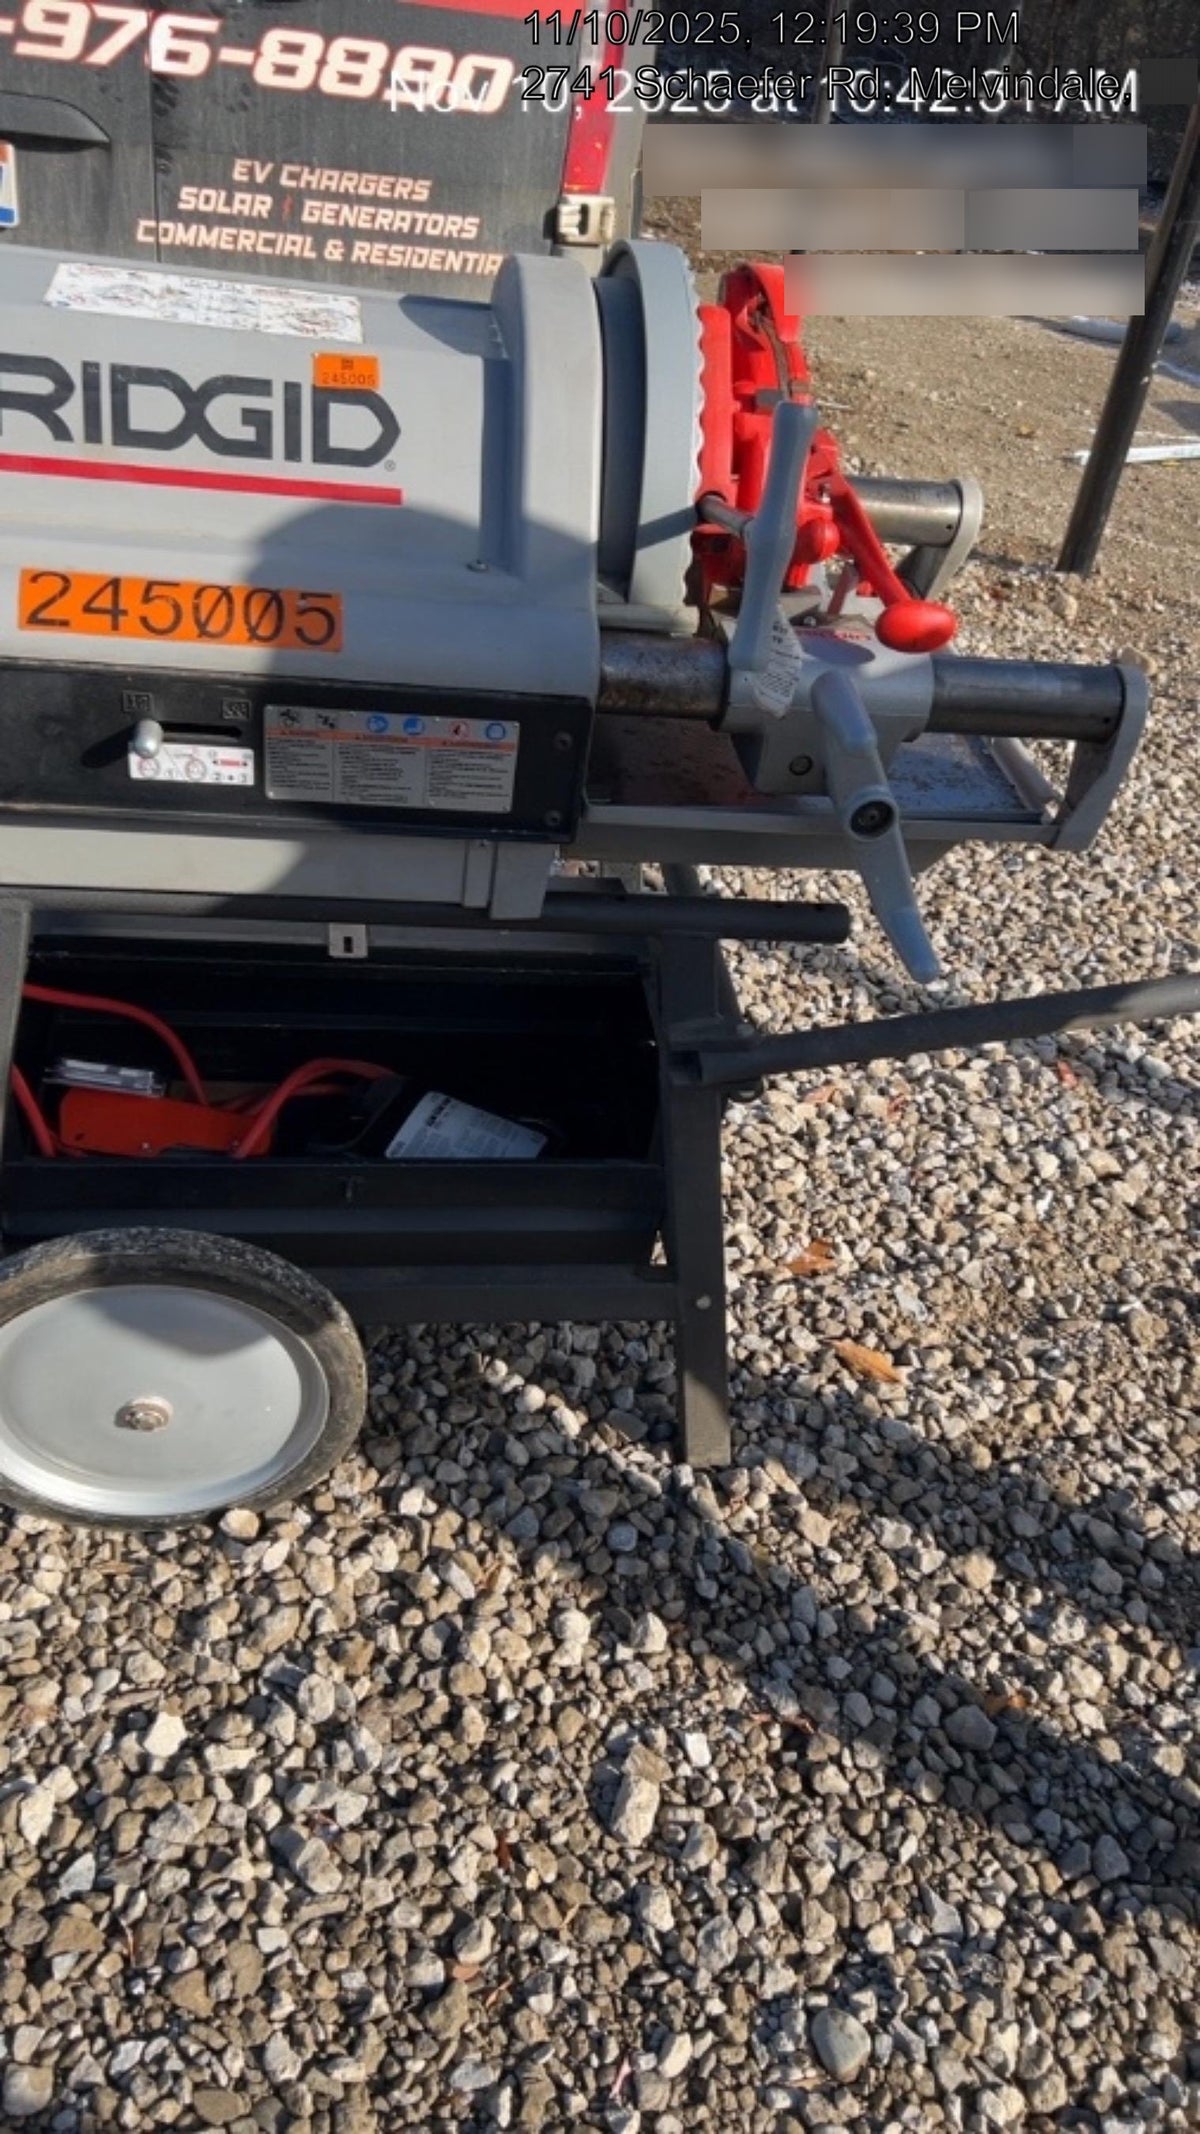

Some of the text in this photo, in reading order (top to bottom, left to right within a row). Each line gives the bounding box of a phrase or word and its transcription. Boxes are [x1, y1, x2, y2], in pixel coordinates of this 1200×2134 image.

[231, 158, 433, 202] EV CHARGERS
[177, 185, 481, 240] SOLAR GENERATORS
[135, 219, 504, 276] COMMERCIAL & RESIDENTIA
[0, 352, 401, 469] RIDGID
[25, 571, 337, 647] 245005
